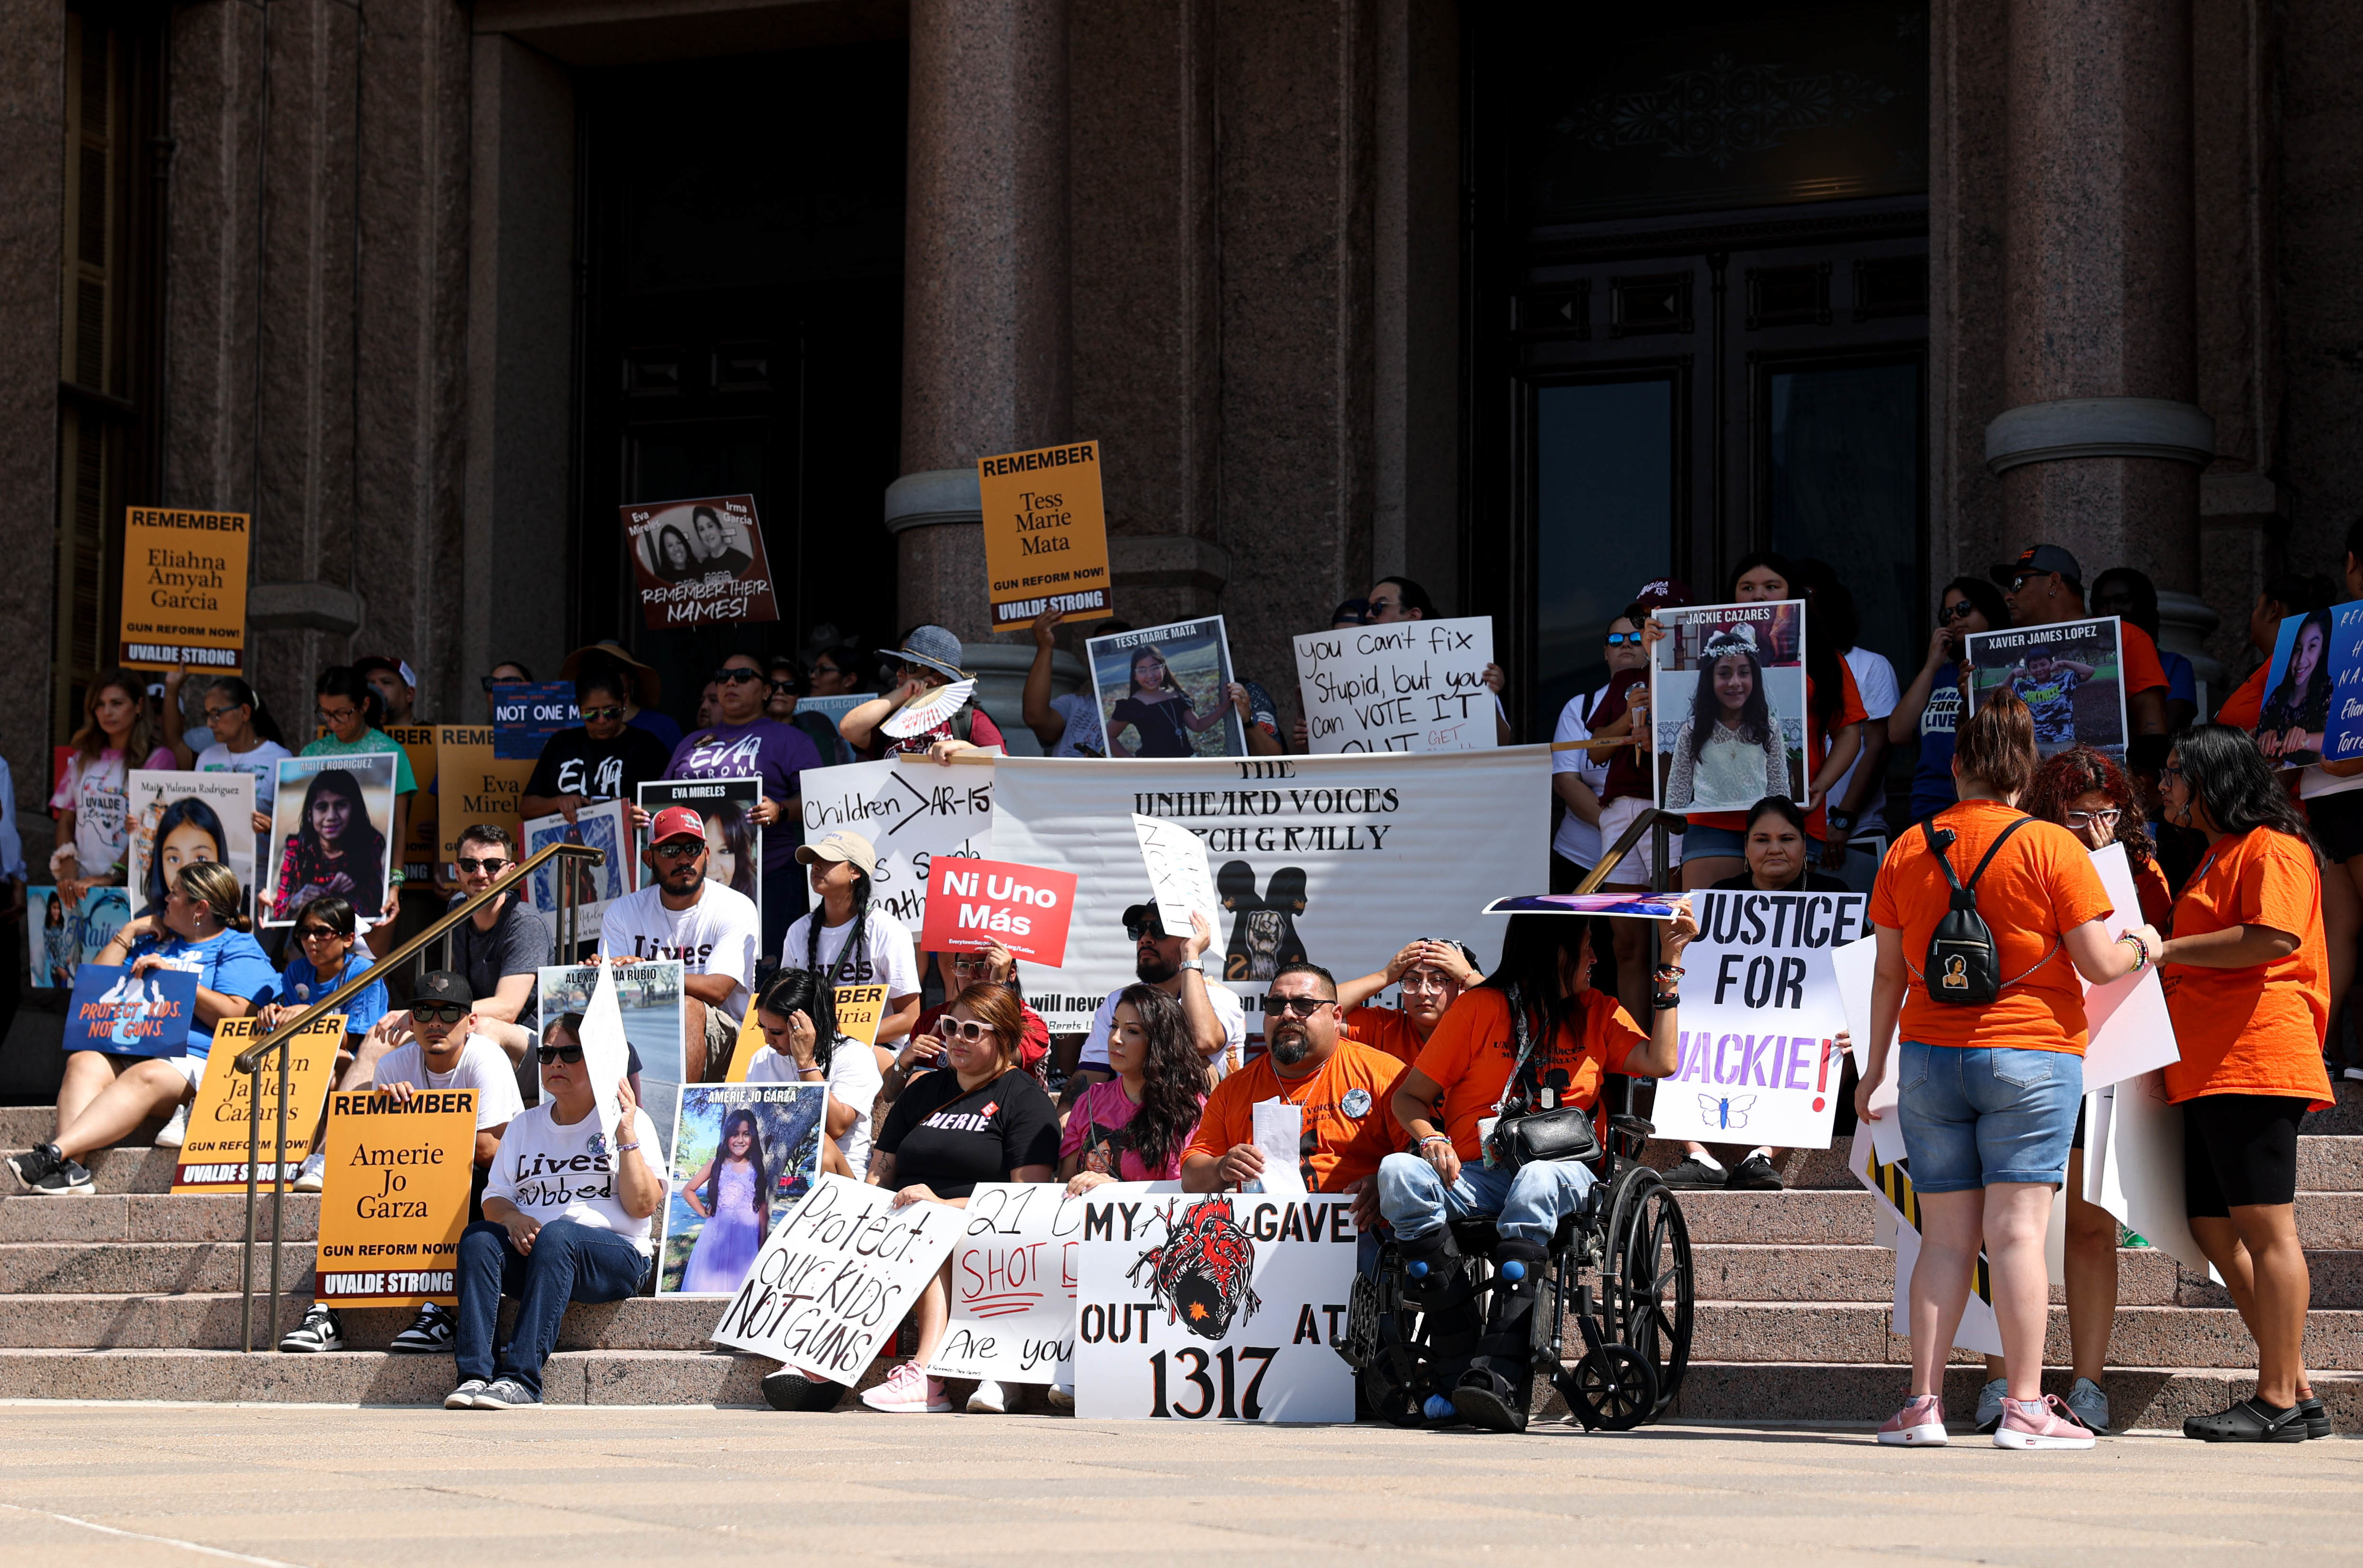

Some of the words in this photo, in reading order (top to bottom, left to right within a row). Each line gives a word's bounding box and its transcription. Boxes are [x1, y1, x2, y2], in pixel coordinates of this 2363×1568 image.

[983, 446, 1094, 477] REMEMBER
[726, 501, 747, 513] Irma
[1020, 492, 1063, 512] Tess
[132, 511, 244, 532] REMEMBER
[631, 511, 650, 523] Eva
[723, 512, 753, 525] Garcia
[1015, 509, 1072, 533] Marie
[629, 520, 661, 537] Mireles
[1021, 535, 1071, 556] Mata
[147, 549, 226, 570] Eliahna
[147, 568, 223, 593] Amyah
[994, 579, 1019, 591] GUN
[1022, 572, 1070, 587] REFORM
[1073, 567, 1104, 579] NOW!
[151, 591, 217, 611] Garcia
[641, 582, 727, 604] REMEMBER
[728, 579, 770, 596] THEIR
[668, 597, 748, 623] NAMES!
[999, 602, 1047, 620] UVALDE
[1049, 591, 1104, 613] STRONG
[1686, 612, 1723, 625] JACKIE
[1725, 608, 1770, 623] CAZARES
[127, 623, 152, 632] GUN
[156, 625, 205, 635] REFORM
[209, 627, 239, 637] NOW!
[1114, 635, 1138, 649] TESS
[1140, 629, 1169, 645] MARIE
[1171, 625, 1197, 638] MATA
[1988, 635, 2025, 650] XAVIER
[2027, 630, 2063, 645] JAMES
[2064, 625, 2097, 640] LOPEZ
[128, 644, 179, 662] UVALDE
[182, 646, 235, 666] STRONG
[1299, 640, 1341, 679] you
[1428, 627, 1473, 654] fix
[1393, 660, 1432, 694] but
[1446, 670, 1488, 700] you
[2339, 667, 2363, 687] NA
[497, 705, 527, 721] NOT
[534, 705, 563, 720] ONE
[801, 701, 828, 711] NICOLE
[1355, 697, 1417, 730] VOTE
[1427, 693, 1483, 722] IT
[1928, 701, 1955, 712] FOR
[1925, 715, 1955, 727] LIVE
[443, 730, 494, 745] REME
[1427, 723, 1465, 745] GET
[2338, 731, 2363, 753] Torre
[690, 733, 762, 770] EVA
[300, 761, 325, 772] MAITE
[327, 758, 373, 769] RODRIGUEZ
[142, 782, 164, 792] Maite
[165, 783, 196, 793] Yuleana
[199, 783, 239, 797] Rodriguez
[482, 775, 520, 793] Eva
[672, 787, 688, 799] EVA
[689, 786, 726, 798] MIRELES
[86, 798, 120, 810] UVALDE
[463, 795, 518, 813] Mirel
[805, 793, 900, 830] Children
[930, 781, 994, 816] AR-15'
[1134, 791, 1281, 816] UNHEARD
[1290, 788, 1399, 815] VOICES
[1283, 825, 1391, 851] RALLY
[942, 870, 980, 896] Ni
[987, 874, 1057, 908] Uno
[958, 903, 1031, 935] Más
[1691, 893, 1862, 948] JUSTICE
[566, 969, 624, 984] ALEXANIA
[628, 969, 656, 981] RUBIO
[817, 961, 873, 982] ves
[1714, 954, 1806, 1009] FOR
[80, 1001, 142, 1020] PROTECT
[148, 1001, 181, 1018] KIDS.
[1030, 994, 1061, 1012] will
[1065, 996, 1105, 1012] neve
[88, 1021, 118, 1038] NOT
[124, 1020, 164, 1038] GUNS.
[221, 1019, 340, 1037] REMBER
[1049, 1021, 1081, 1030] Berets
[1662, 1031, 1831, 1112] JACKIE!
[335, 1094, 472, 1115] REMEMBER
[708, 1091, 746, 1103] AMERIE
[748, 1091, 762, 1102] JO
[764, 1090, 796, 1102] GARZA
[188, 1142, 215, 1150] GUN
[275, 1140, 308, 1149] OW!
[350, 1142, 444, 1166] Amerie
[183, 1165, 237, 1183] UVALDE
[516, 1152, 611, 1183] Lives
[378, 1169, 406, 1198] Jo
[357, 1196, 428, 1219] Garza
[968, 1187, 1037, 1235] 21
[783, 1181, 931, 1261] Protect
[1084, 1202, 1142, 1241] MY
[1255, 1202, 1357, 1243] GAVE
[323, 1245, 353, 1257] GUN
[359, 1244, 417, 1256] REFORM
[962, 1242, 1047, 1298] SHOT
[325, 1273, 384, 1294] UVALDE
[387, 1272, 453, 1292] STRONG
[816, 1260, 901, 1326] KIDS
[722, 1279, 814, 1339] NOT
[784, 1308, 871, 1371] GUNS
[1081, 1303, 1156, 1344] OUT
[1293, 1303, 1346, 1344] AT
[941, 1329, 997, 1361] Are
[1021, 1339, 1074, 1371] you
[1149, 1346, 1280, 1419] 1317
